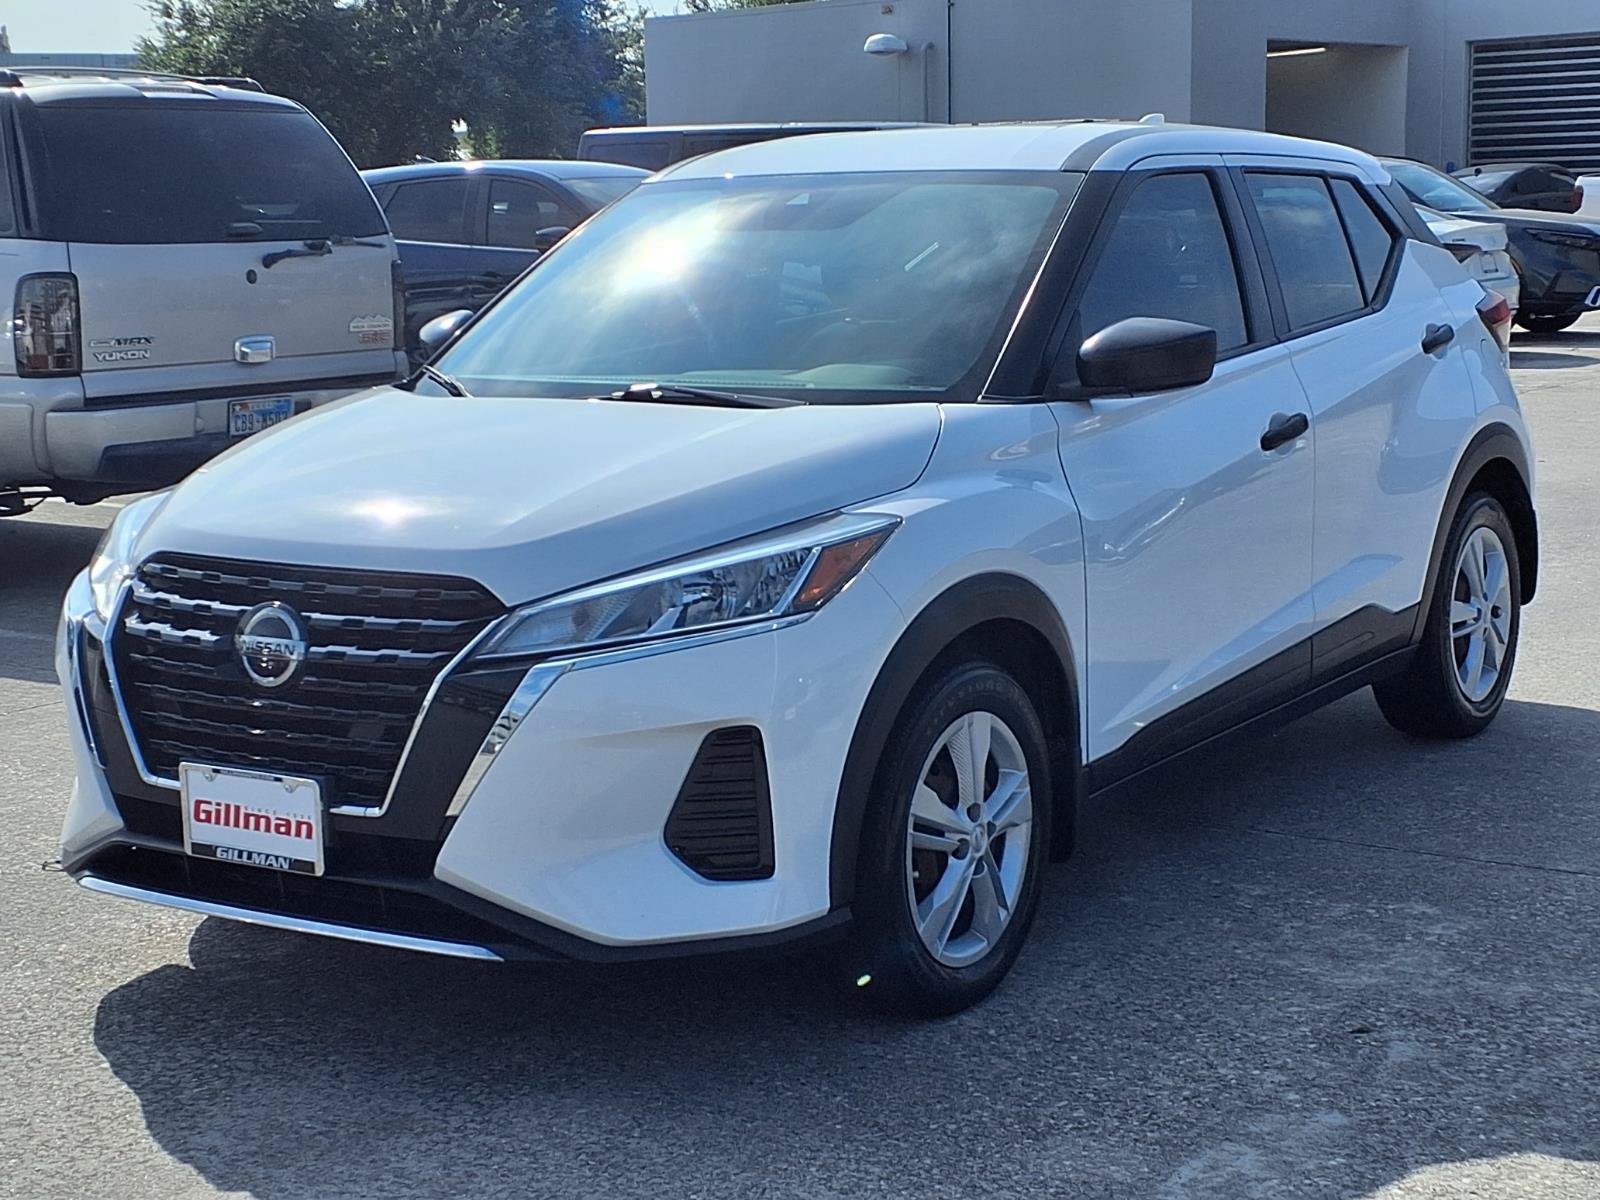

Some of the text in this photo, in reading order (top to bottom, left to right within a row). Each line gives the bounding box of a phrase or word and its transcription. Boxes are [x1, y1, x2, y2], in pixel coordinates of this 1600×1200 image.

[92, 349, 151, 362] YUKON
[240, 638, 297, 658] NISSAN
[193, 799, 314, 840] Gillman
[216, 846, 290, 869] GILLMAN
